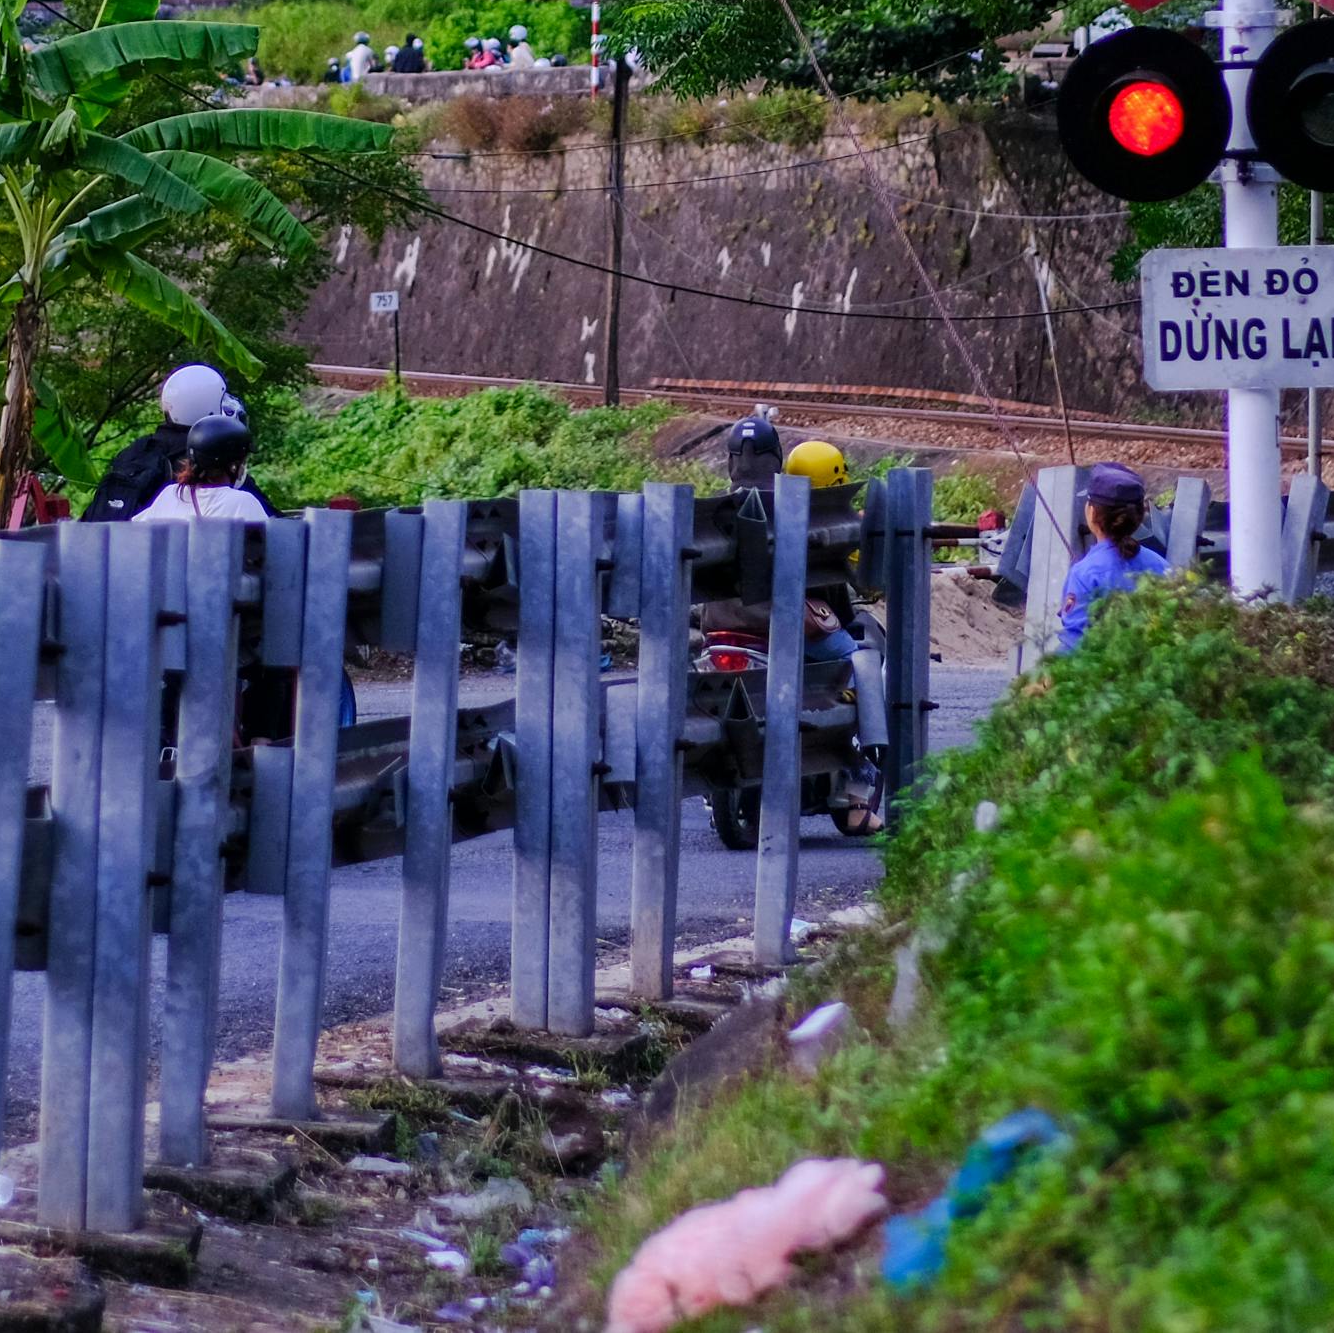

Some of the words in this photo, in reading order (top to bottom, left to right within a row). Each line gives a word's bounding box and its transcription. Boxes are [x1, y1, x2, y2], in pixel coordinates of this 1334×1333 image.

[1170, 261, 1250, 298] ĐÈN
[1264, 257, 1318, 296] ĐỎ
[1159, 309, 1268, 362] DỪNG
